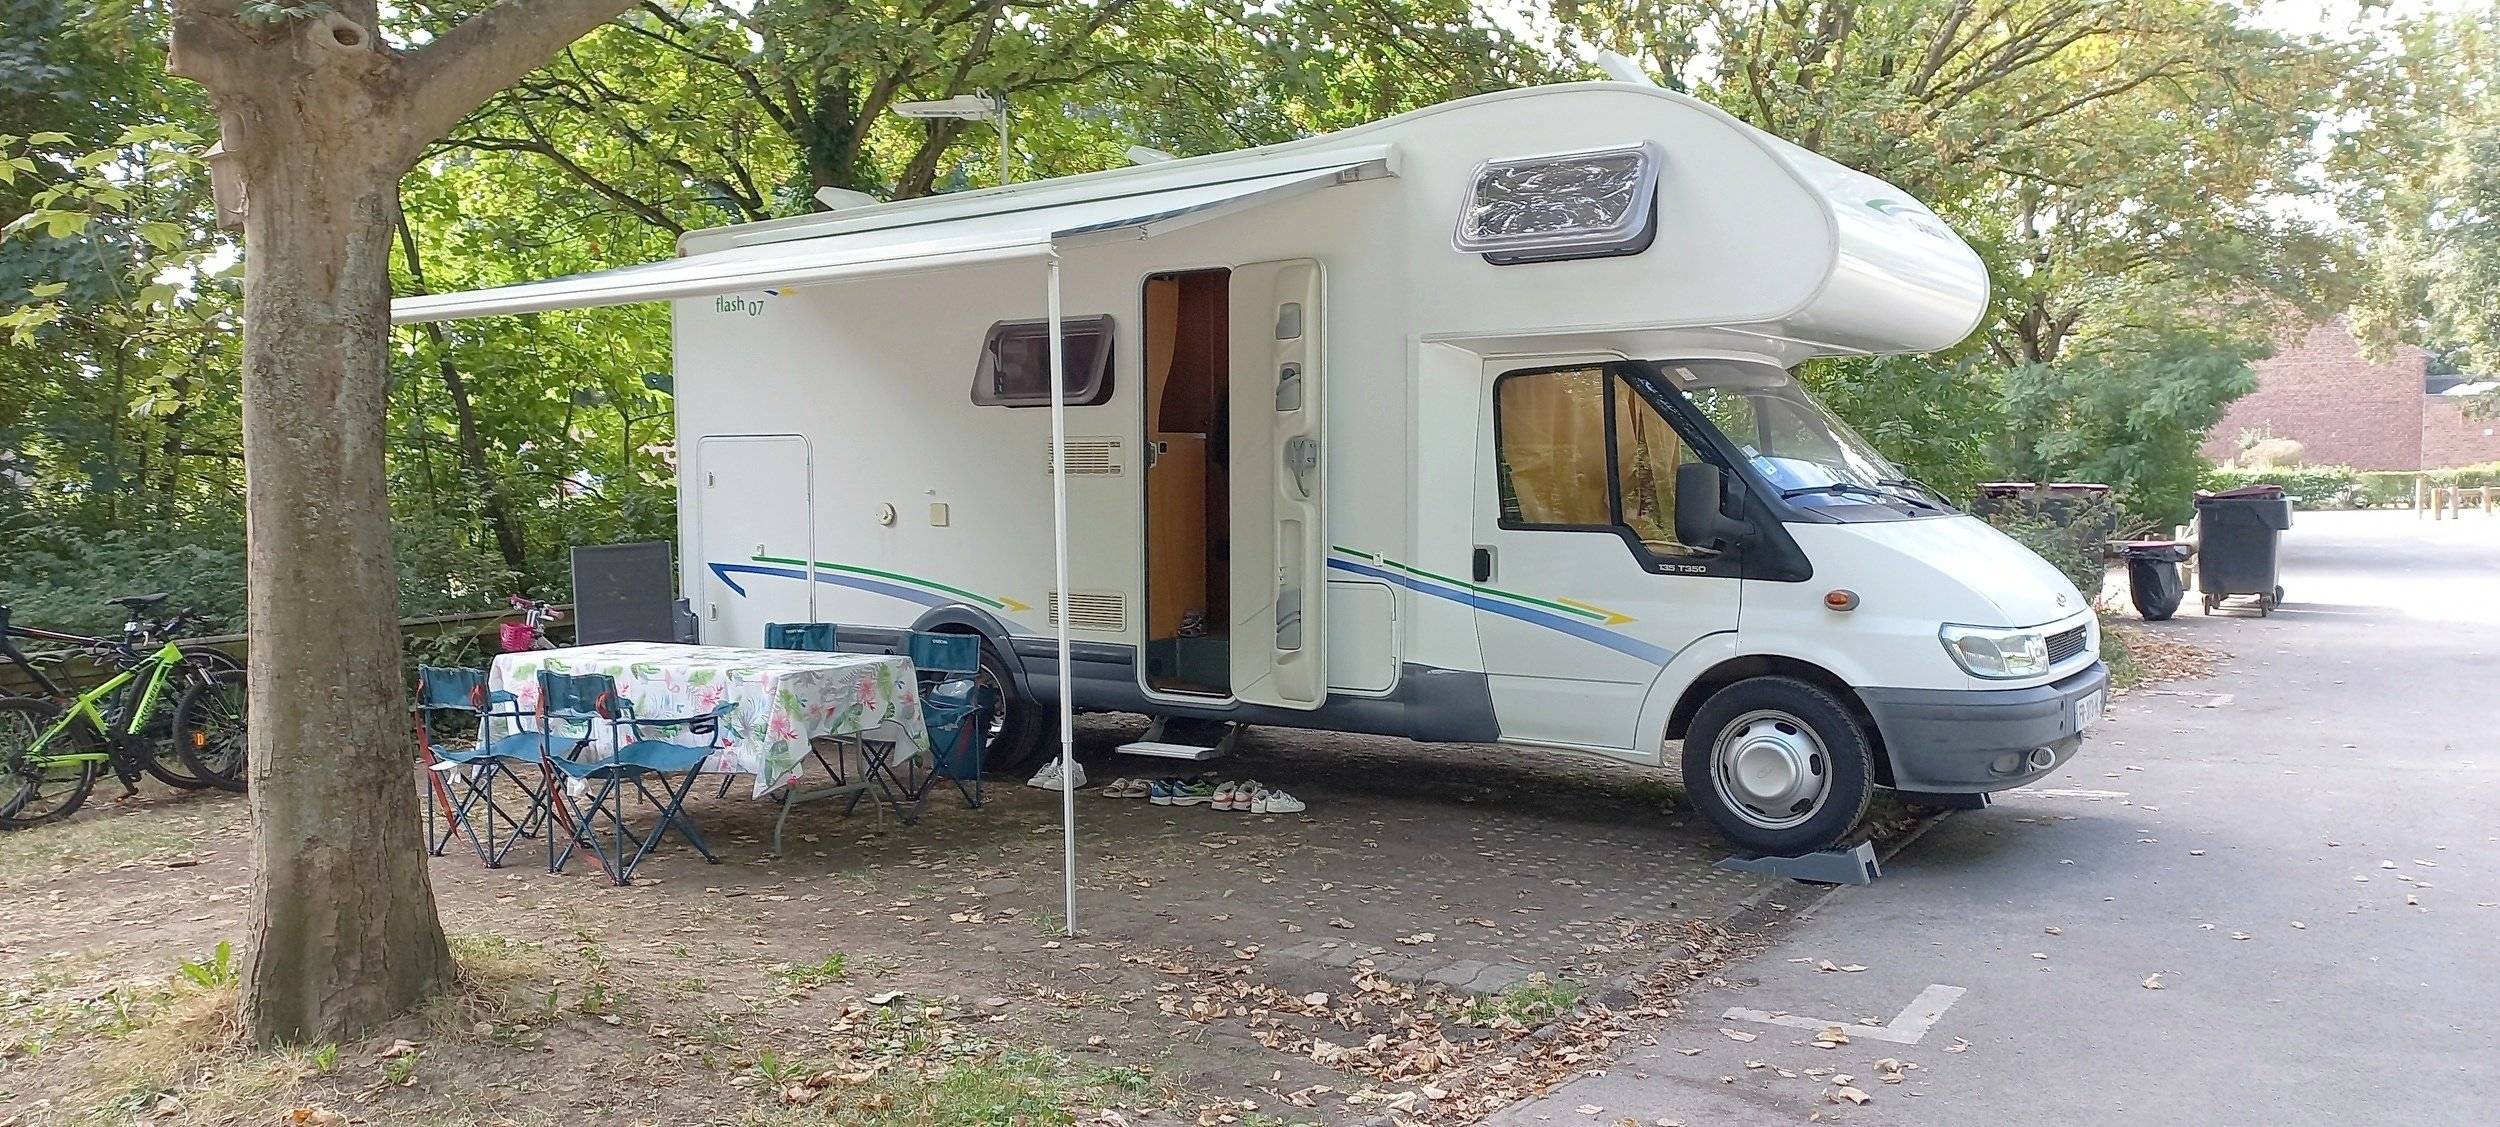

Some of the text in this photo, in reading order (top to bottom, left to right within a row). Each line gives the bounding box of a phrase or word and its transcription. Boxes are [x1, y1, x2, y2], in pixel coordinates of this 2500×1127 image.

[716, 295, 765, 317] flash 07
[1659, 564, 1707, 573] 135 T350
